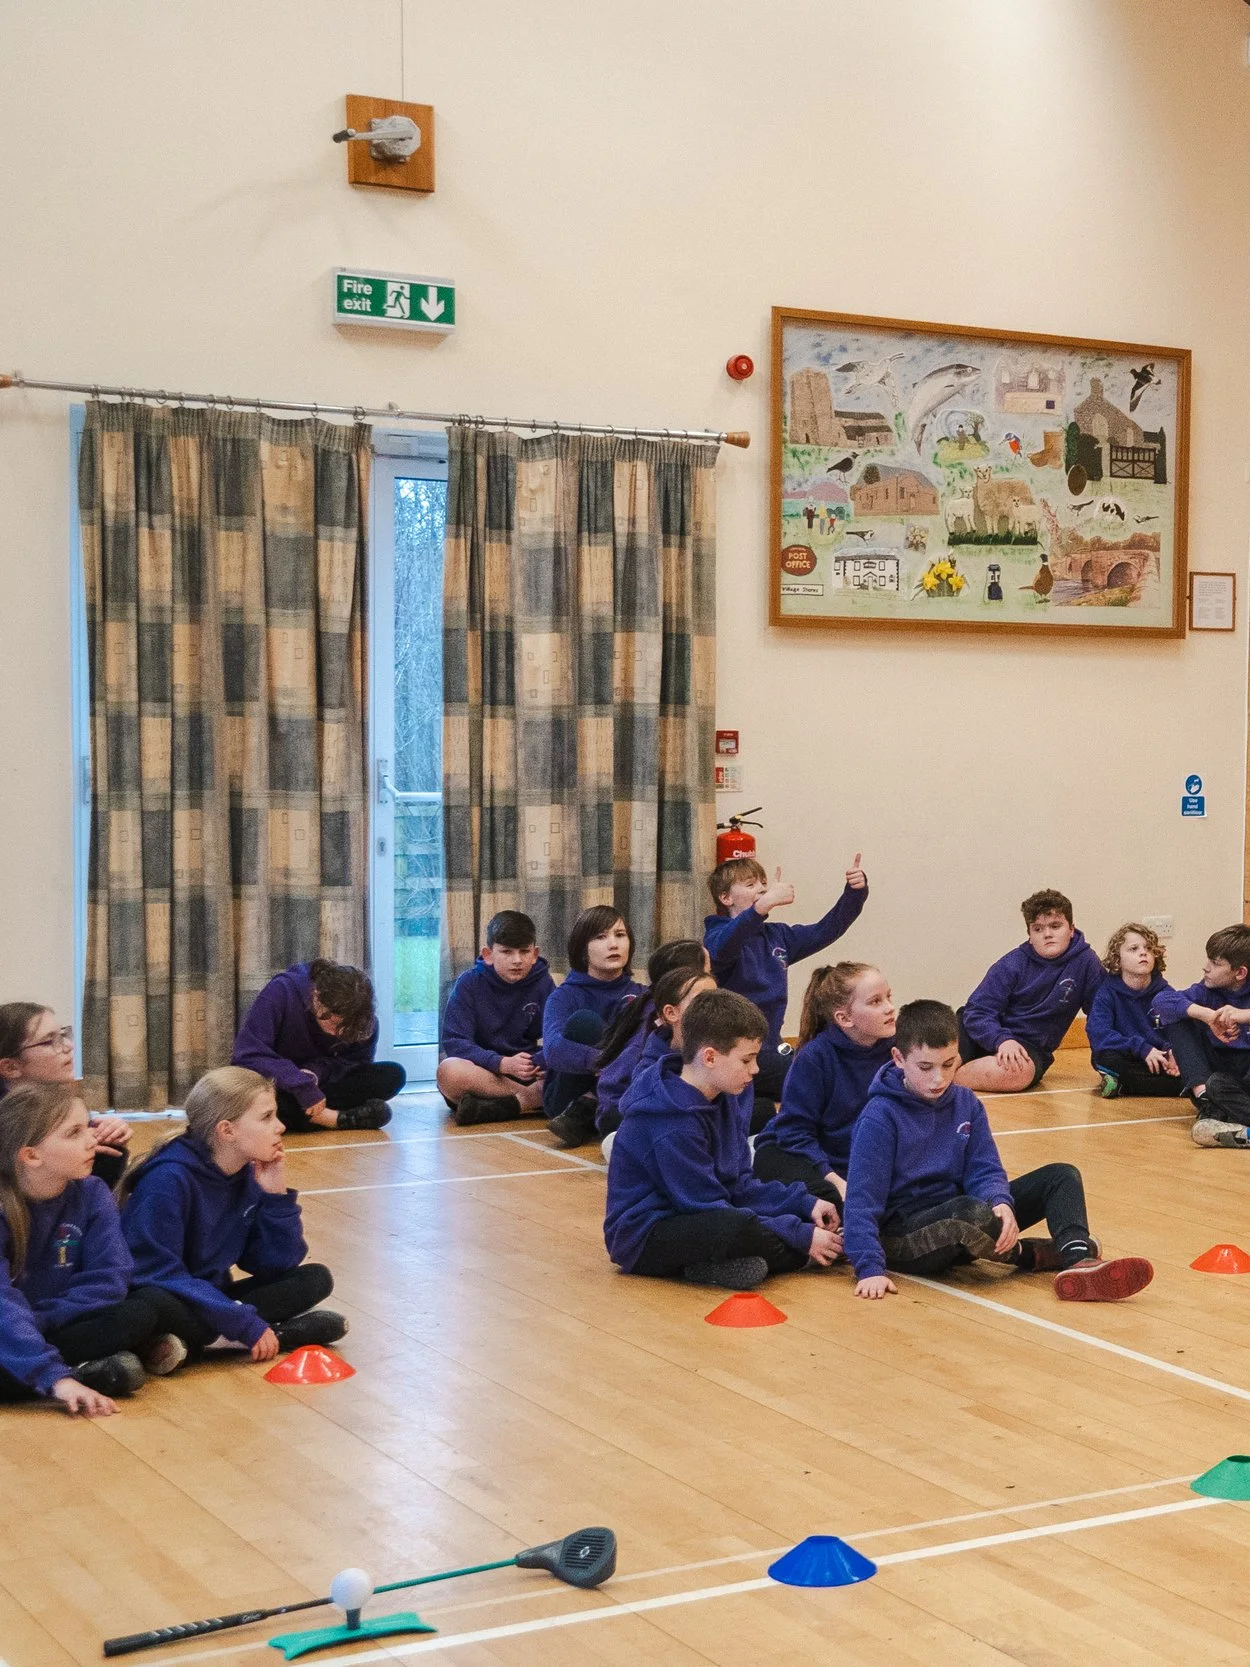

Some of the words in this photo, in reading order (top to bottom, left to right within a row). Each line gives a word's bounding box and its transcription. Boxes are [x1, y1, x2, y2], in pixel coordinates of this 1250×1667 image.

[342, 279, 373, 296] Fire
[343, 297, 372, 312] exit
[788, 552, 808, 560] POST
[785, 560, 811, 569] OFFICE
